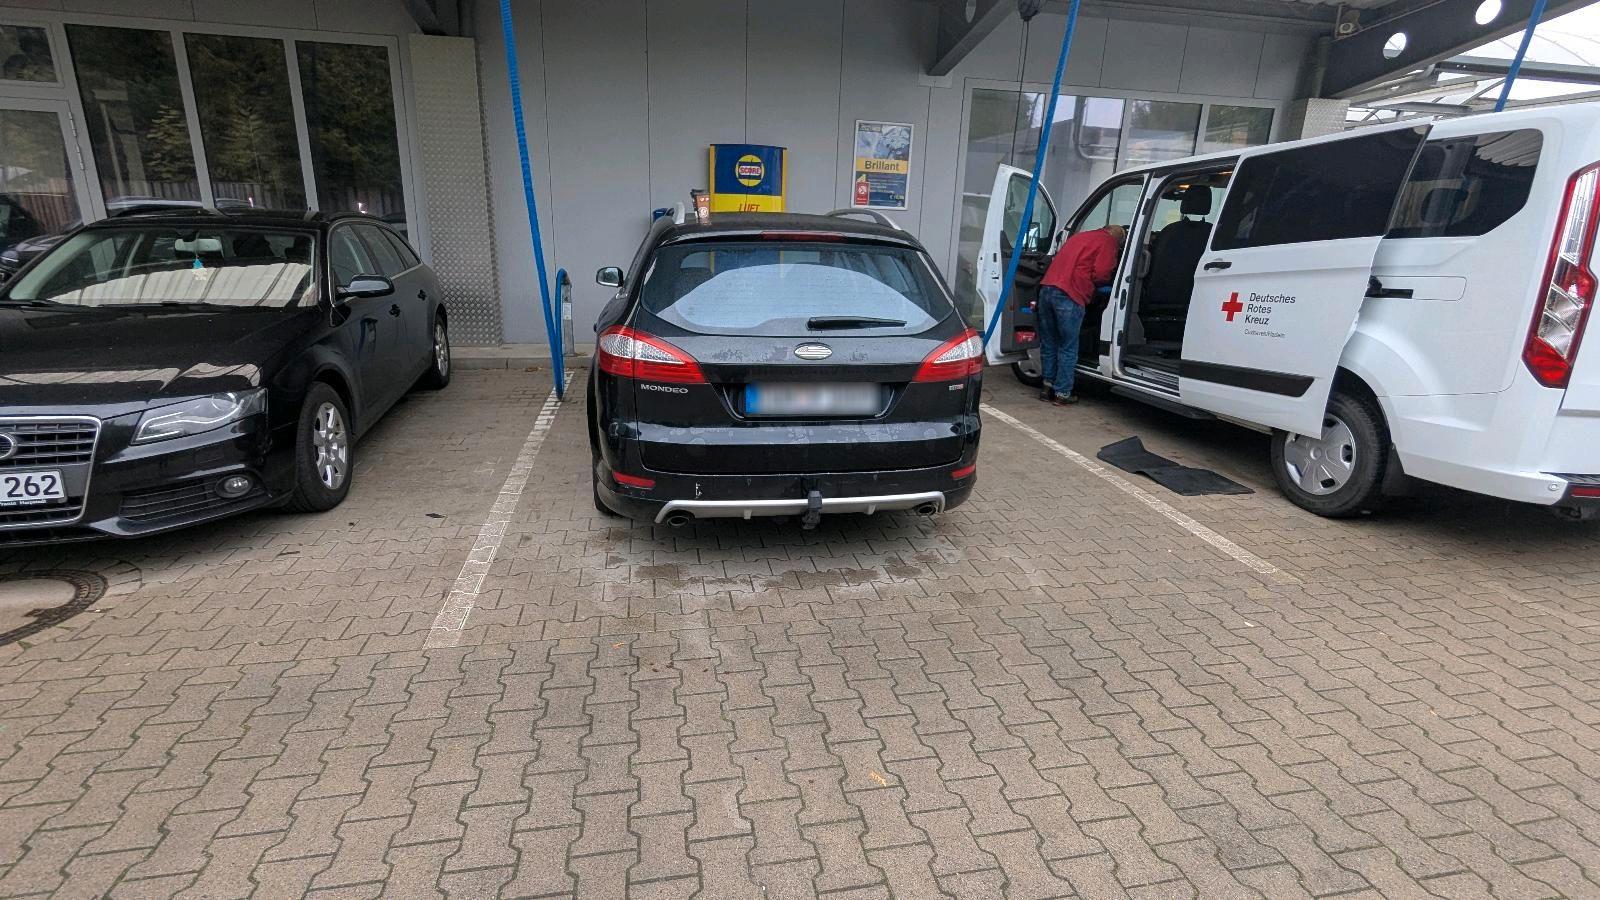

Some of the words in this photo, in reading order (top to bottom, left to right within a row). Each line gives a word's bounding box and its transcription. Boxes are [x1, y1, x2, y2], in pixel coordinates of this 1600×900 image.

[865, 160, 899, 171] Brillant
[1249, 292, 1296, 304] Deutsches
[1247, 304, 1272, 314] Rotes
[1245, 315, 1270, 325] Kreuz
[640, 383, 689, 394] MONDEO
[5, 474, 60, 498] 262
